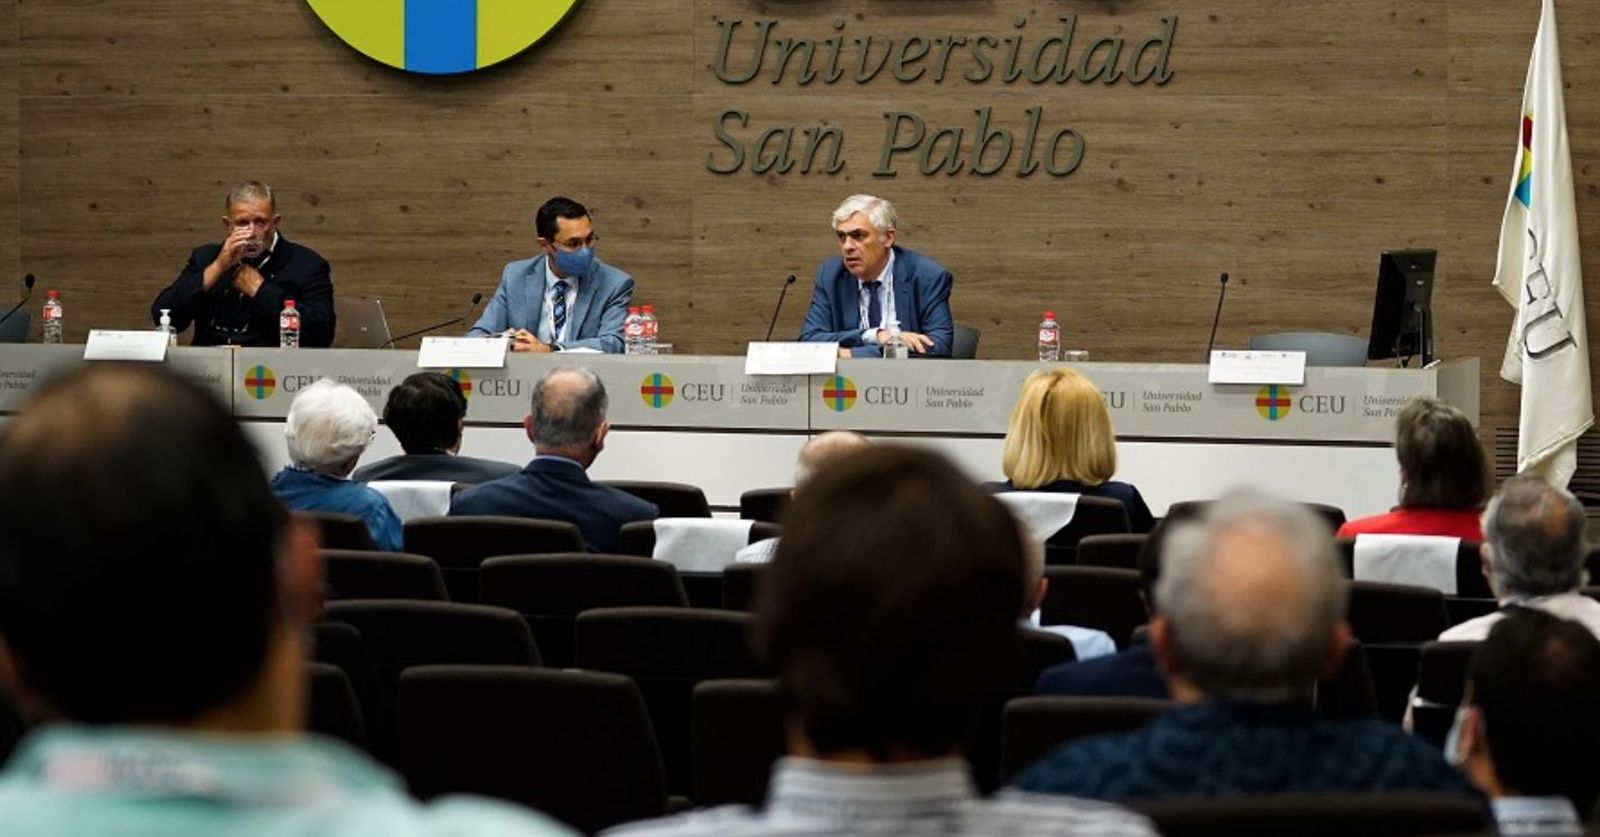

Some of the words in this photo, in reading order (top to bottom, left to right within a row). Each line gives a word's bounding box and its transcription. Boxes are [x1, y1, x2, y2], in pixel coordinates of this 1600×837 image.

[710, 14, 1179, 86] Universidad
[704, 108, 847, 176] San
[872, 106, 1086, 177] Pablo
[479, 378, 521, 397] CEU
[681, 382, 725, 402] CEU
[740, 383, 798, 394] Universidad
[925, 386, 985, 397] Universidad
[865, 385, 909, 406] CEU
[1143, 390, 1203, 402] Universidad
[925, 398, 944, 408] San
[945, 398, 974, 409] Pablo
[1142, 402, 1161, 413] San
[1162, 402, 1192, 413] Pablo
[1299, 395, 1346, 415] CEU
[1362, 408, 1382, 417] San
